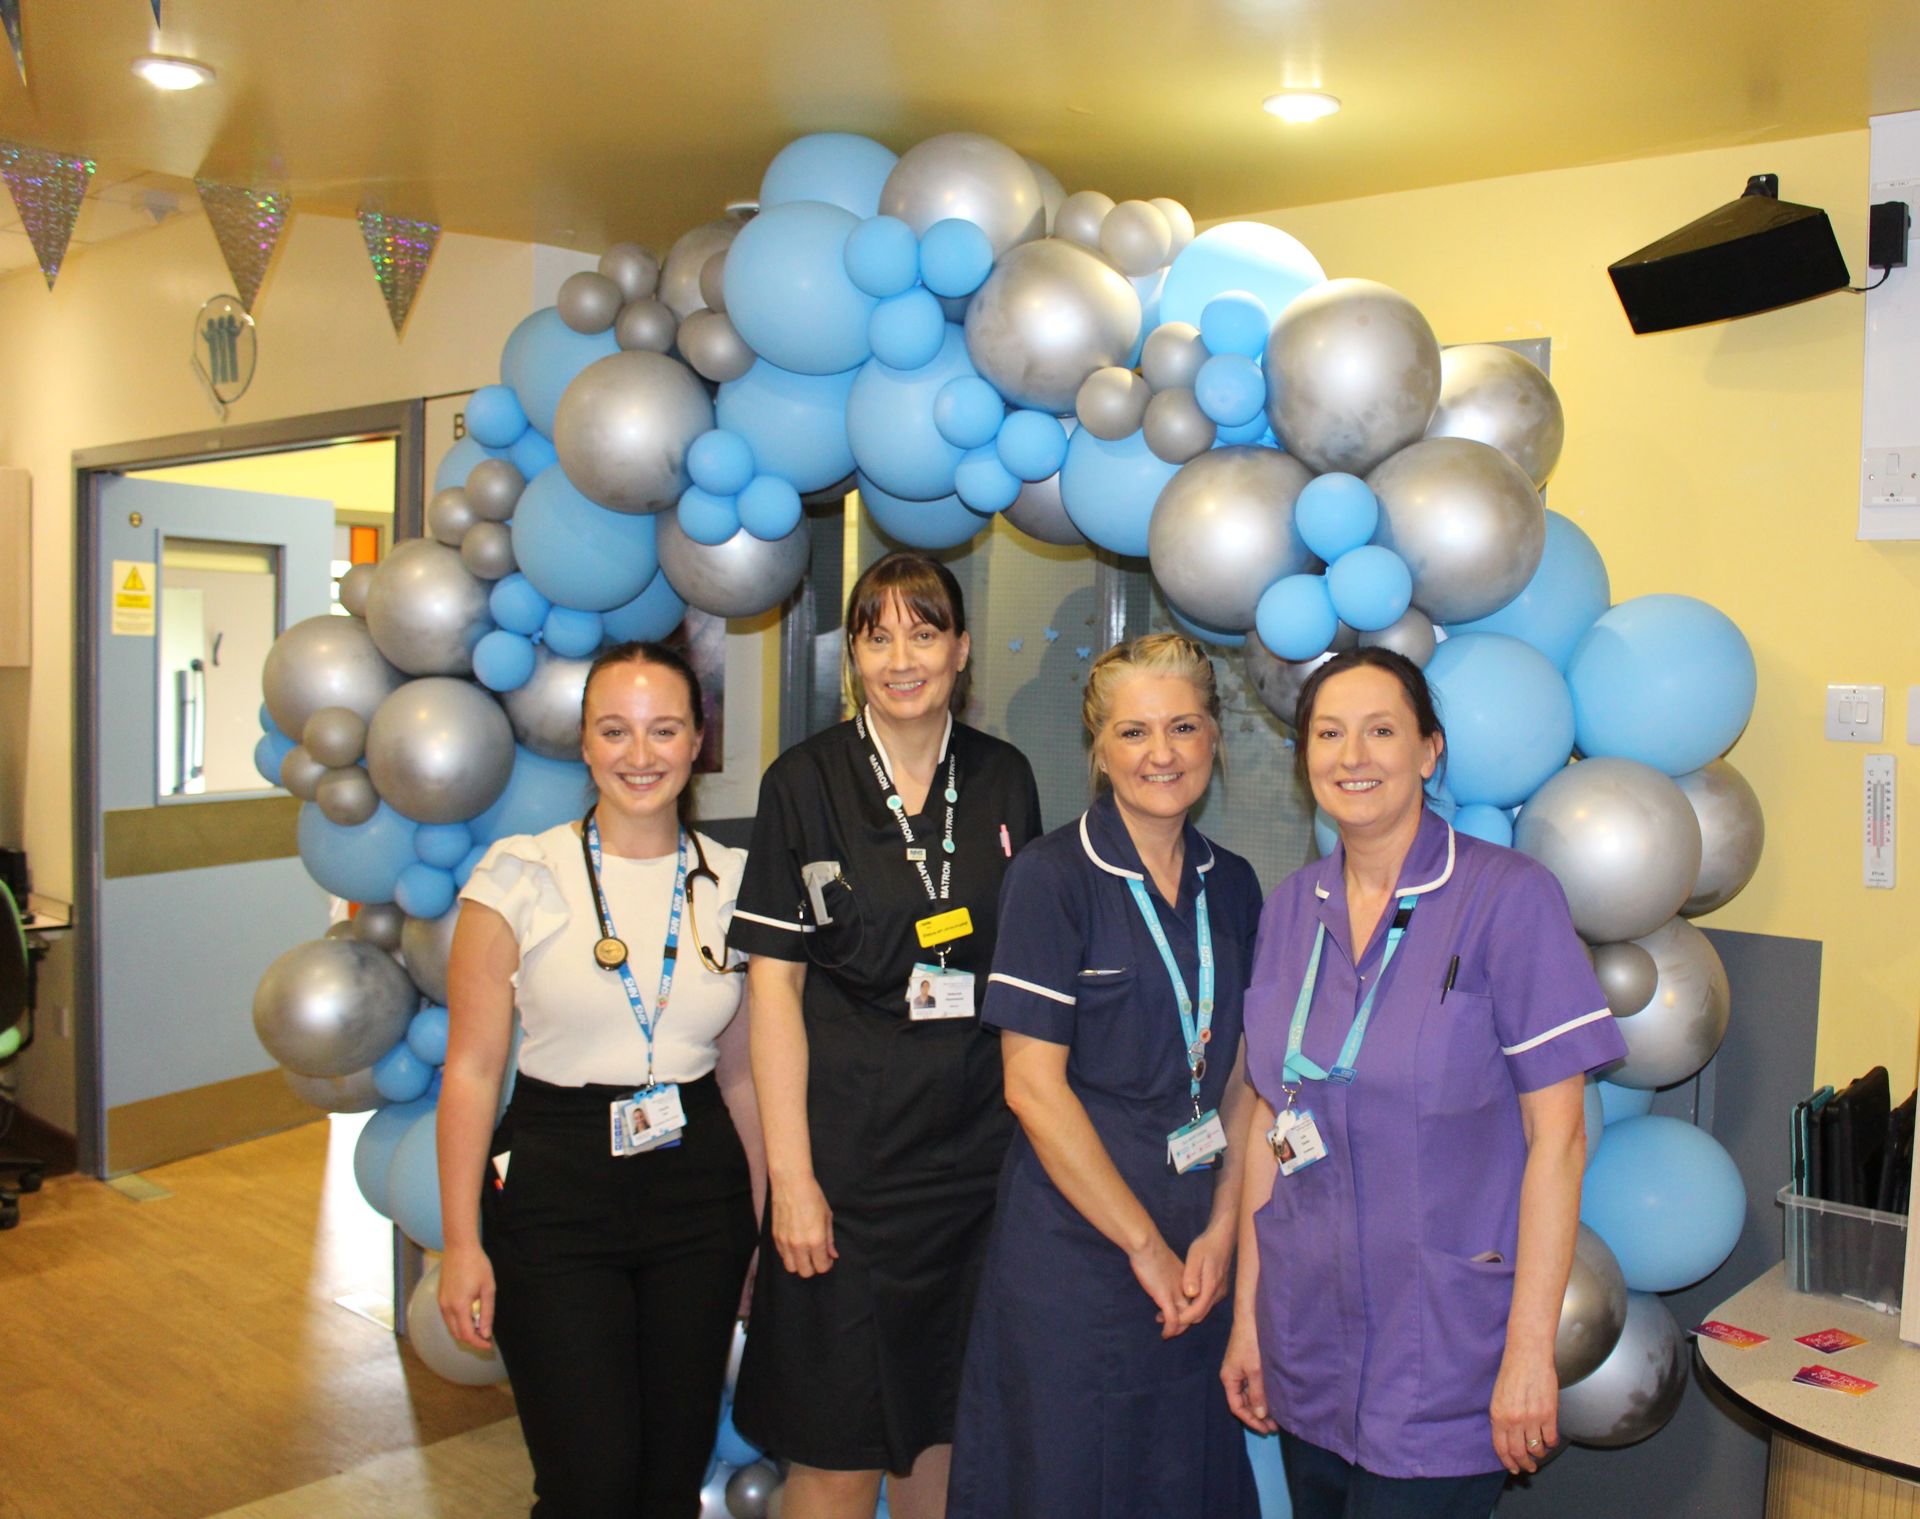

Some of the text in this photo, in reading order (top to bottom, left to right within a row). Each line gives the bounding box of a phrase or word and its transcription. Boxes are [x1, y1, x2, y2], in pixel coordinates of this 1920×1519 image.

[869, 754, 890, 791] MATRON
[916, 861, 937, 900] MATRON
[940, 860, 951, 899] MATRON
[624, 977, 639, 998] NHS
